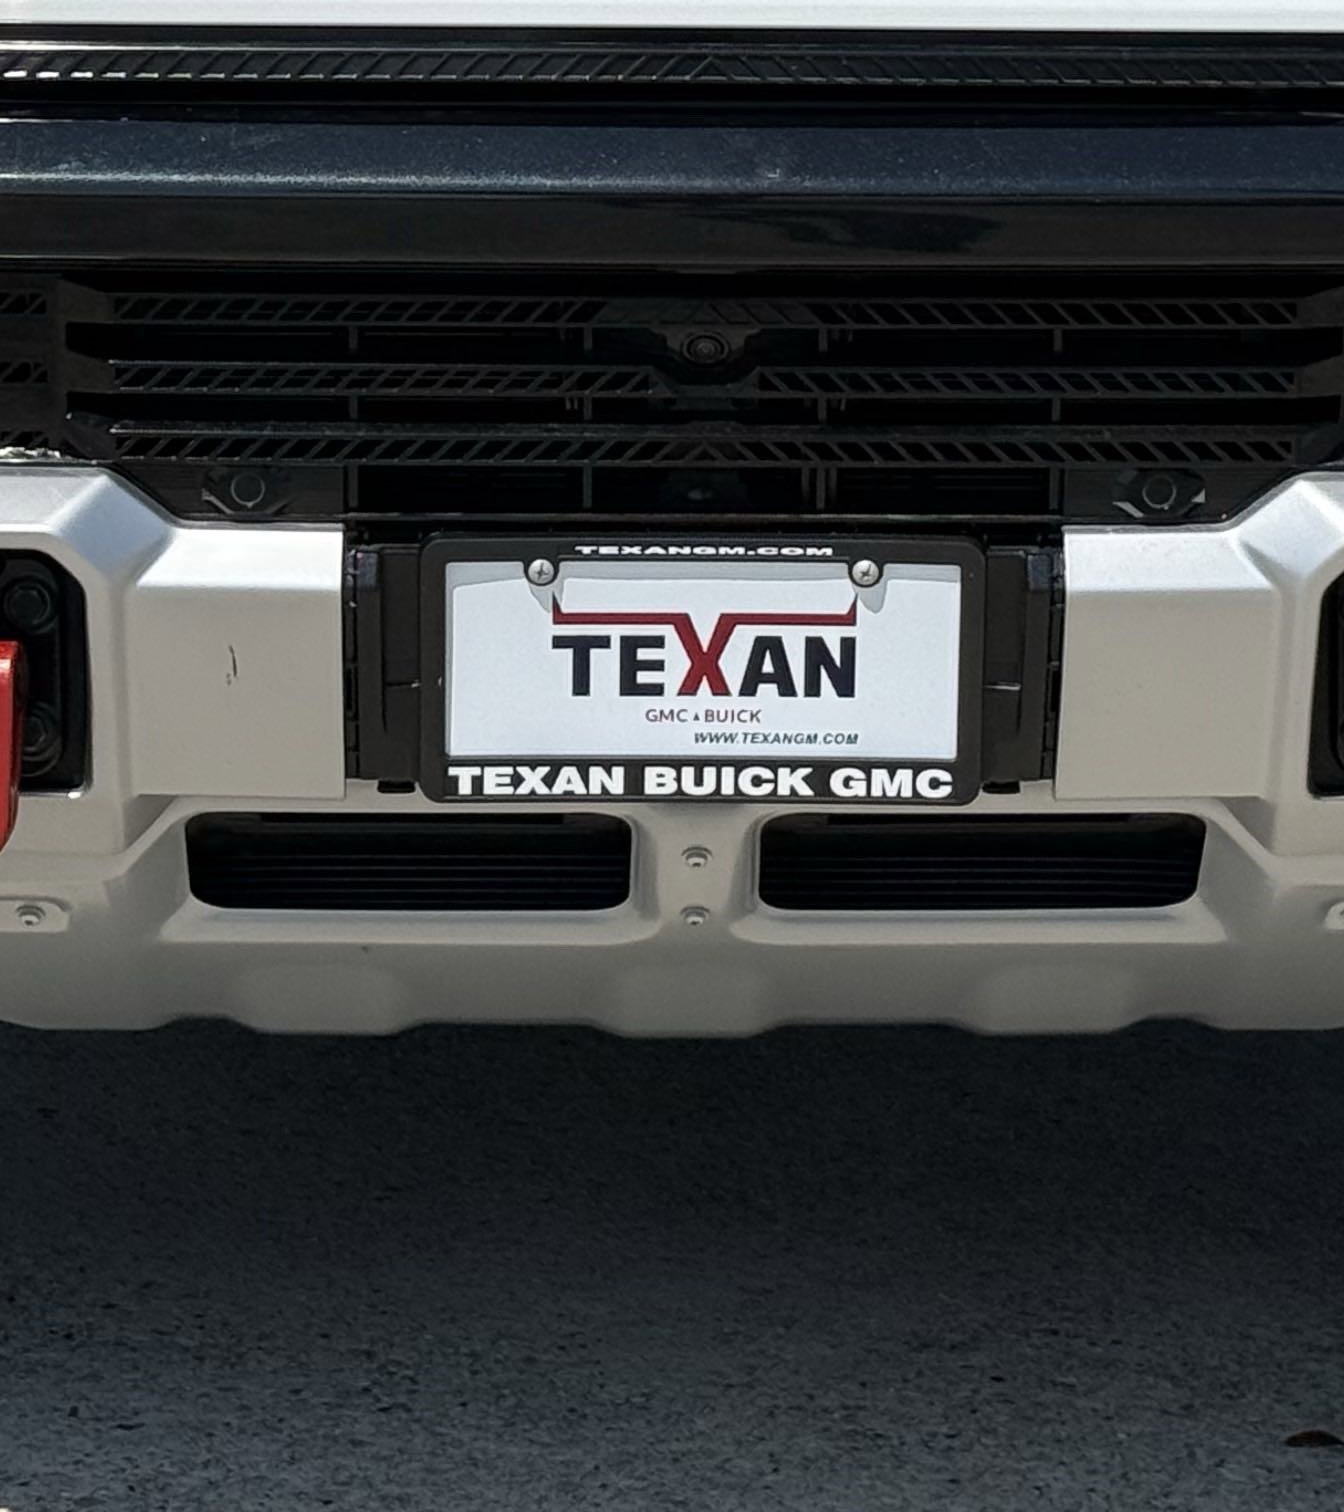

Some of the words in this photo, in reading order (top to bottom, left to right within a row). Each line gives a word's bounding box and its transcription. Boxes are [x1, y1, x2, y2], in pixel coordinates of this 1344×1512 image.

[574, 545, 834, 557] TEXANGM.COM
[551, 612, 858, 699] TEXAN
[644, 708, 689, 724] GMC
[704, 708, 763, 724] BUICK
[693, 732, 859, 746] WWW.TEXANGM.COM
[447, 766, 626, 797] TEXAN
[643, 766, 815, 798] BUICK
[828, 767, 955, 799] GMC
